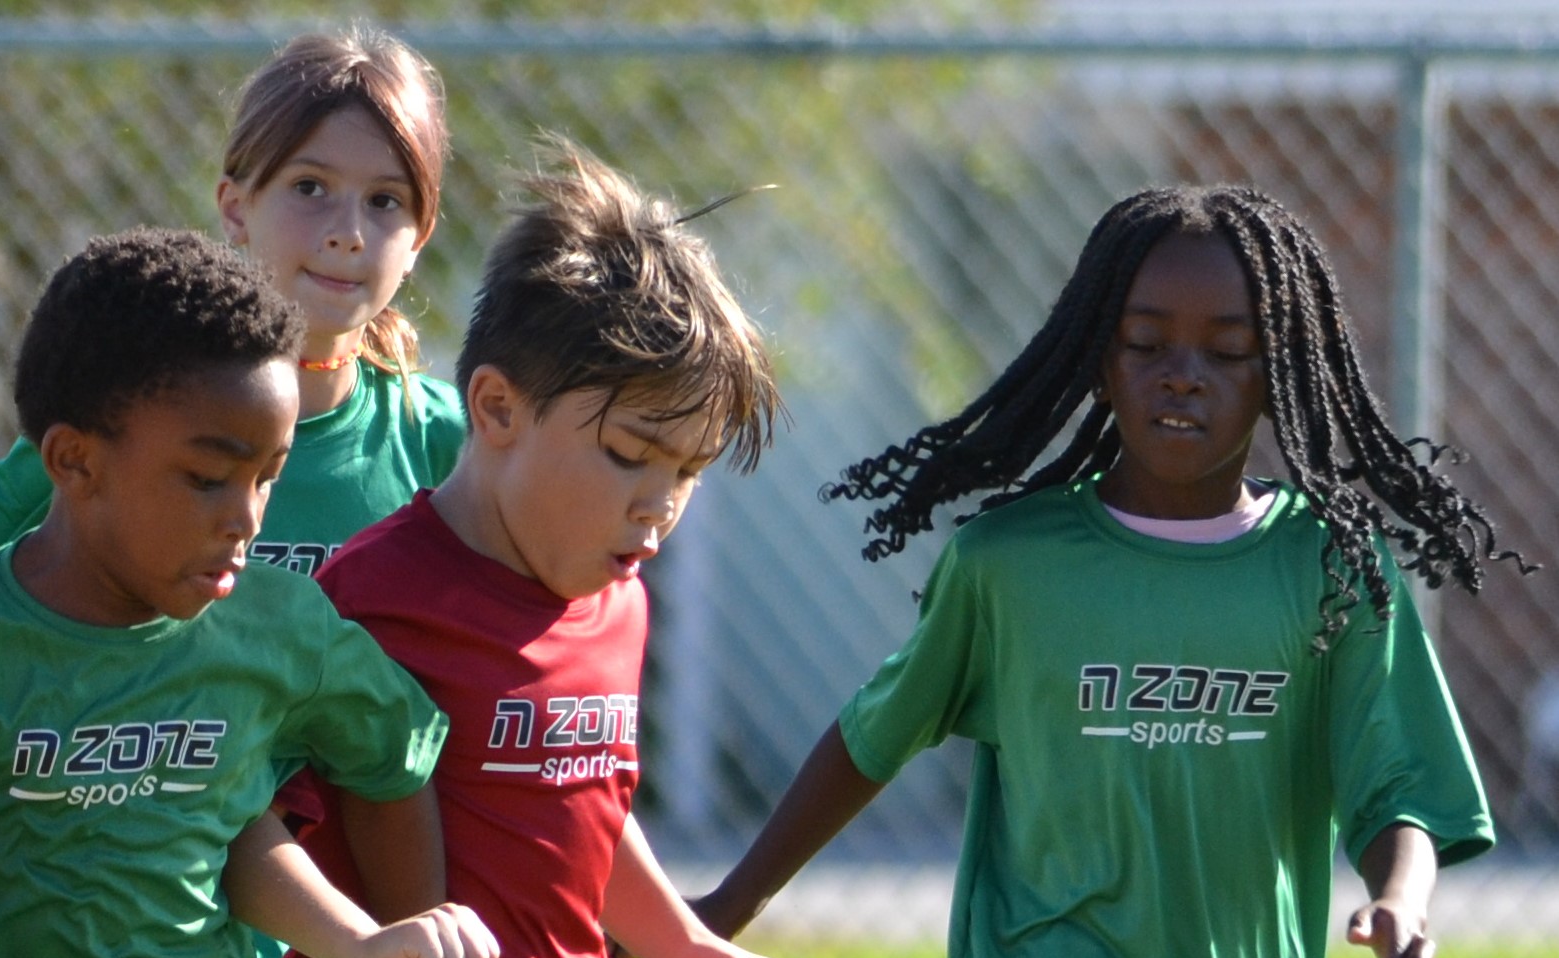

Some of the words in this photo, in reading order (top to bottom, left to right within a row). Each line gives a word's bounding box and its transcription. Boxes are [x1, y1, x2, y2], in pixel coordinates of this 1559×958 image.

[1126, 664, 1289, 716] ZONE
[63, 720, 227, 775] ZONE
[1129, 718, 1225, 749] sports
[541, 749, 618, 786] sports
